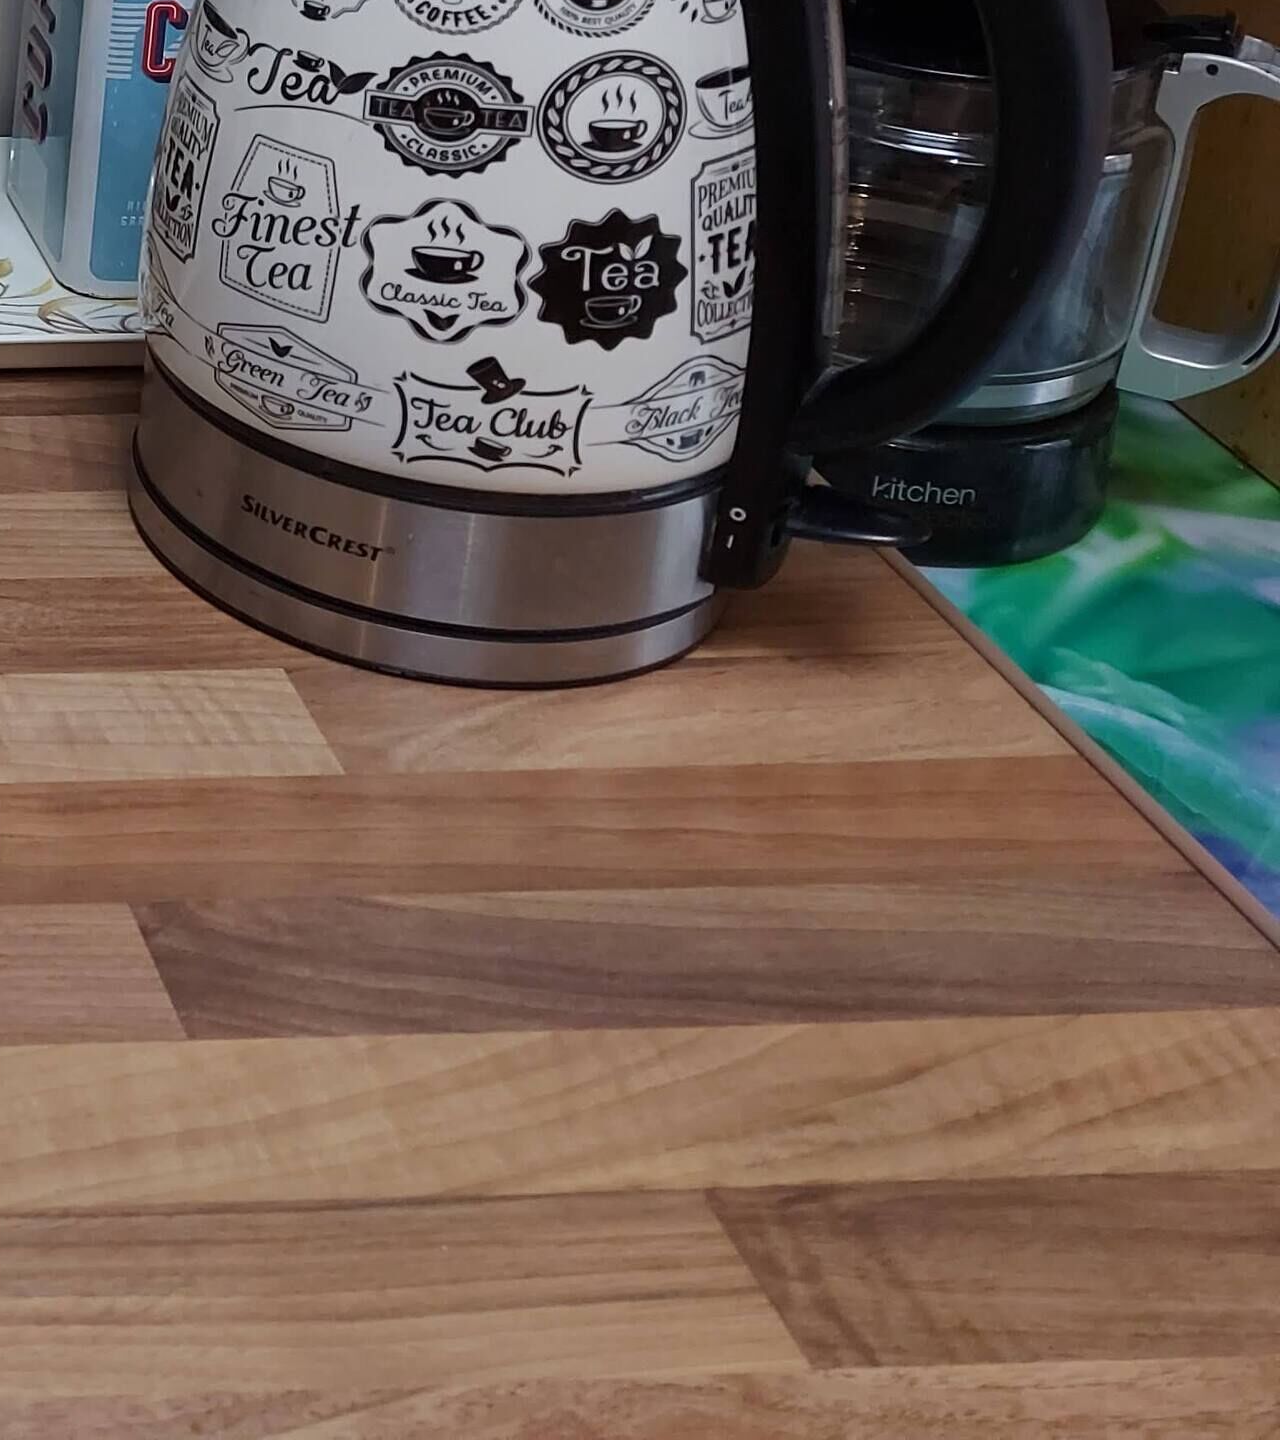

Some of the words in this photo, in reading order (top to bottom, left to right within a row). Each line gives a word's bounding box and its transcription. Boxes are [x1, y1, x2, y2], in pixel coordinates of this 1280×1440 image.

[415, 0, 490, 28] COFFEE
[247, 43, 341, 106] Tea
[408, 68, 493, 96] PREMIUM
[375, 99, 416, 120] TEA
[483, 110, 525, 129] TEA
[406, 138, 481, 161] CLASSIC
[698, 167, 756, 218] PREMIU
[702, 193, 756, 231] QUALIT
[211, 192, 361, 248] Finest
[237, 244, 312, 291] Tea
[560, 245, 660, 292] Tea
[380, 282, 462, 309] Classic
[467, 291, 508, 312] Tea
[217, 342, 285, 388] Green
[296, 371, 351, 408] Tea
[410, 396, 481, 435] Tea
[490, 407, 574, 439] Club
[625, 396, 704, 436] Black
[871, 475, 977, 505] kitchen
